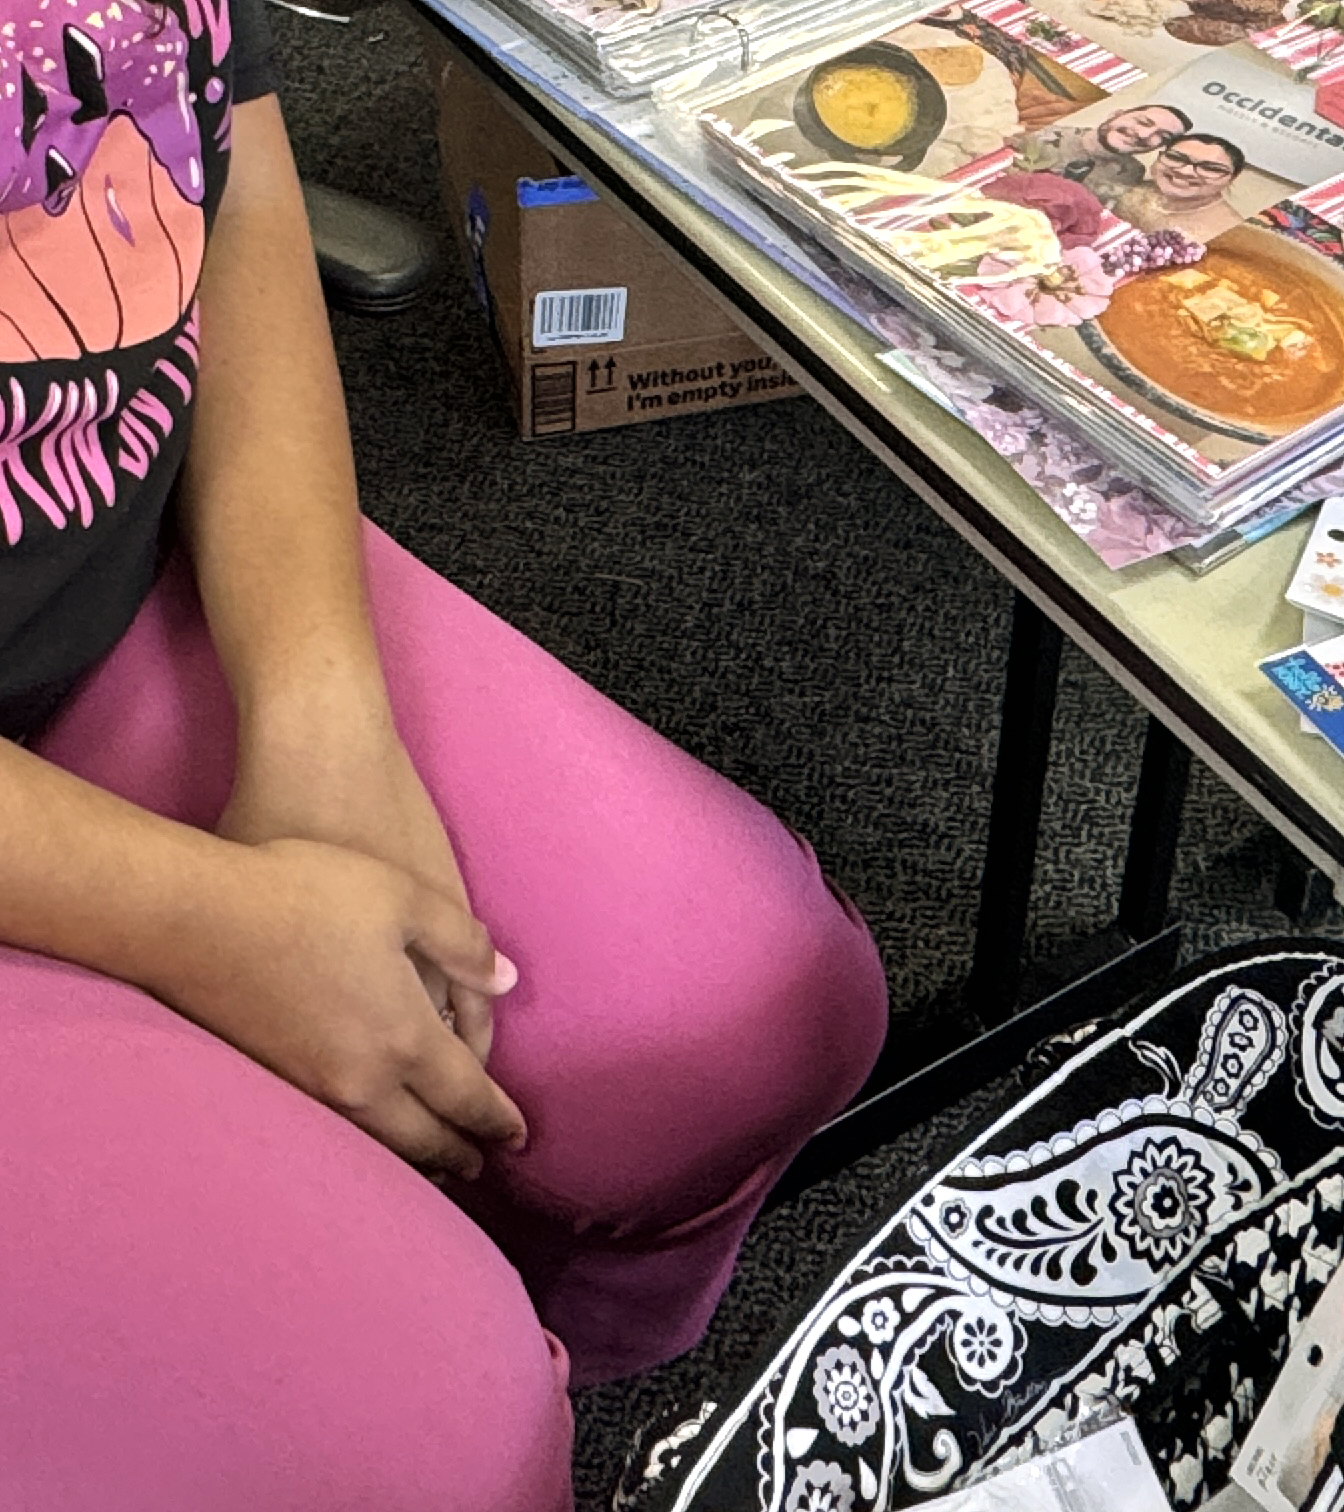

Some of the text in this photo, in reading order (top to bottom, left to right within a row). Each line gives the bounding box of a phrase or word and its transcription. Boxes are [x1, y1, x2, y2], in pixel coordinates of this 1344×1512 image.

[627, 364, 725, 390] Without
[626, 392, 663, 412] I'm
[666, 380, 743, 405] empty
